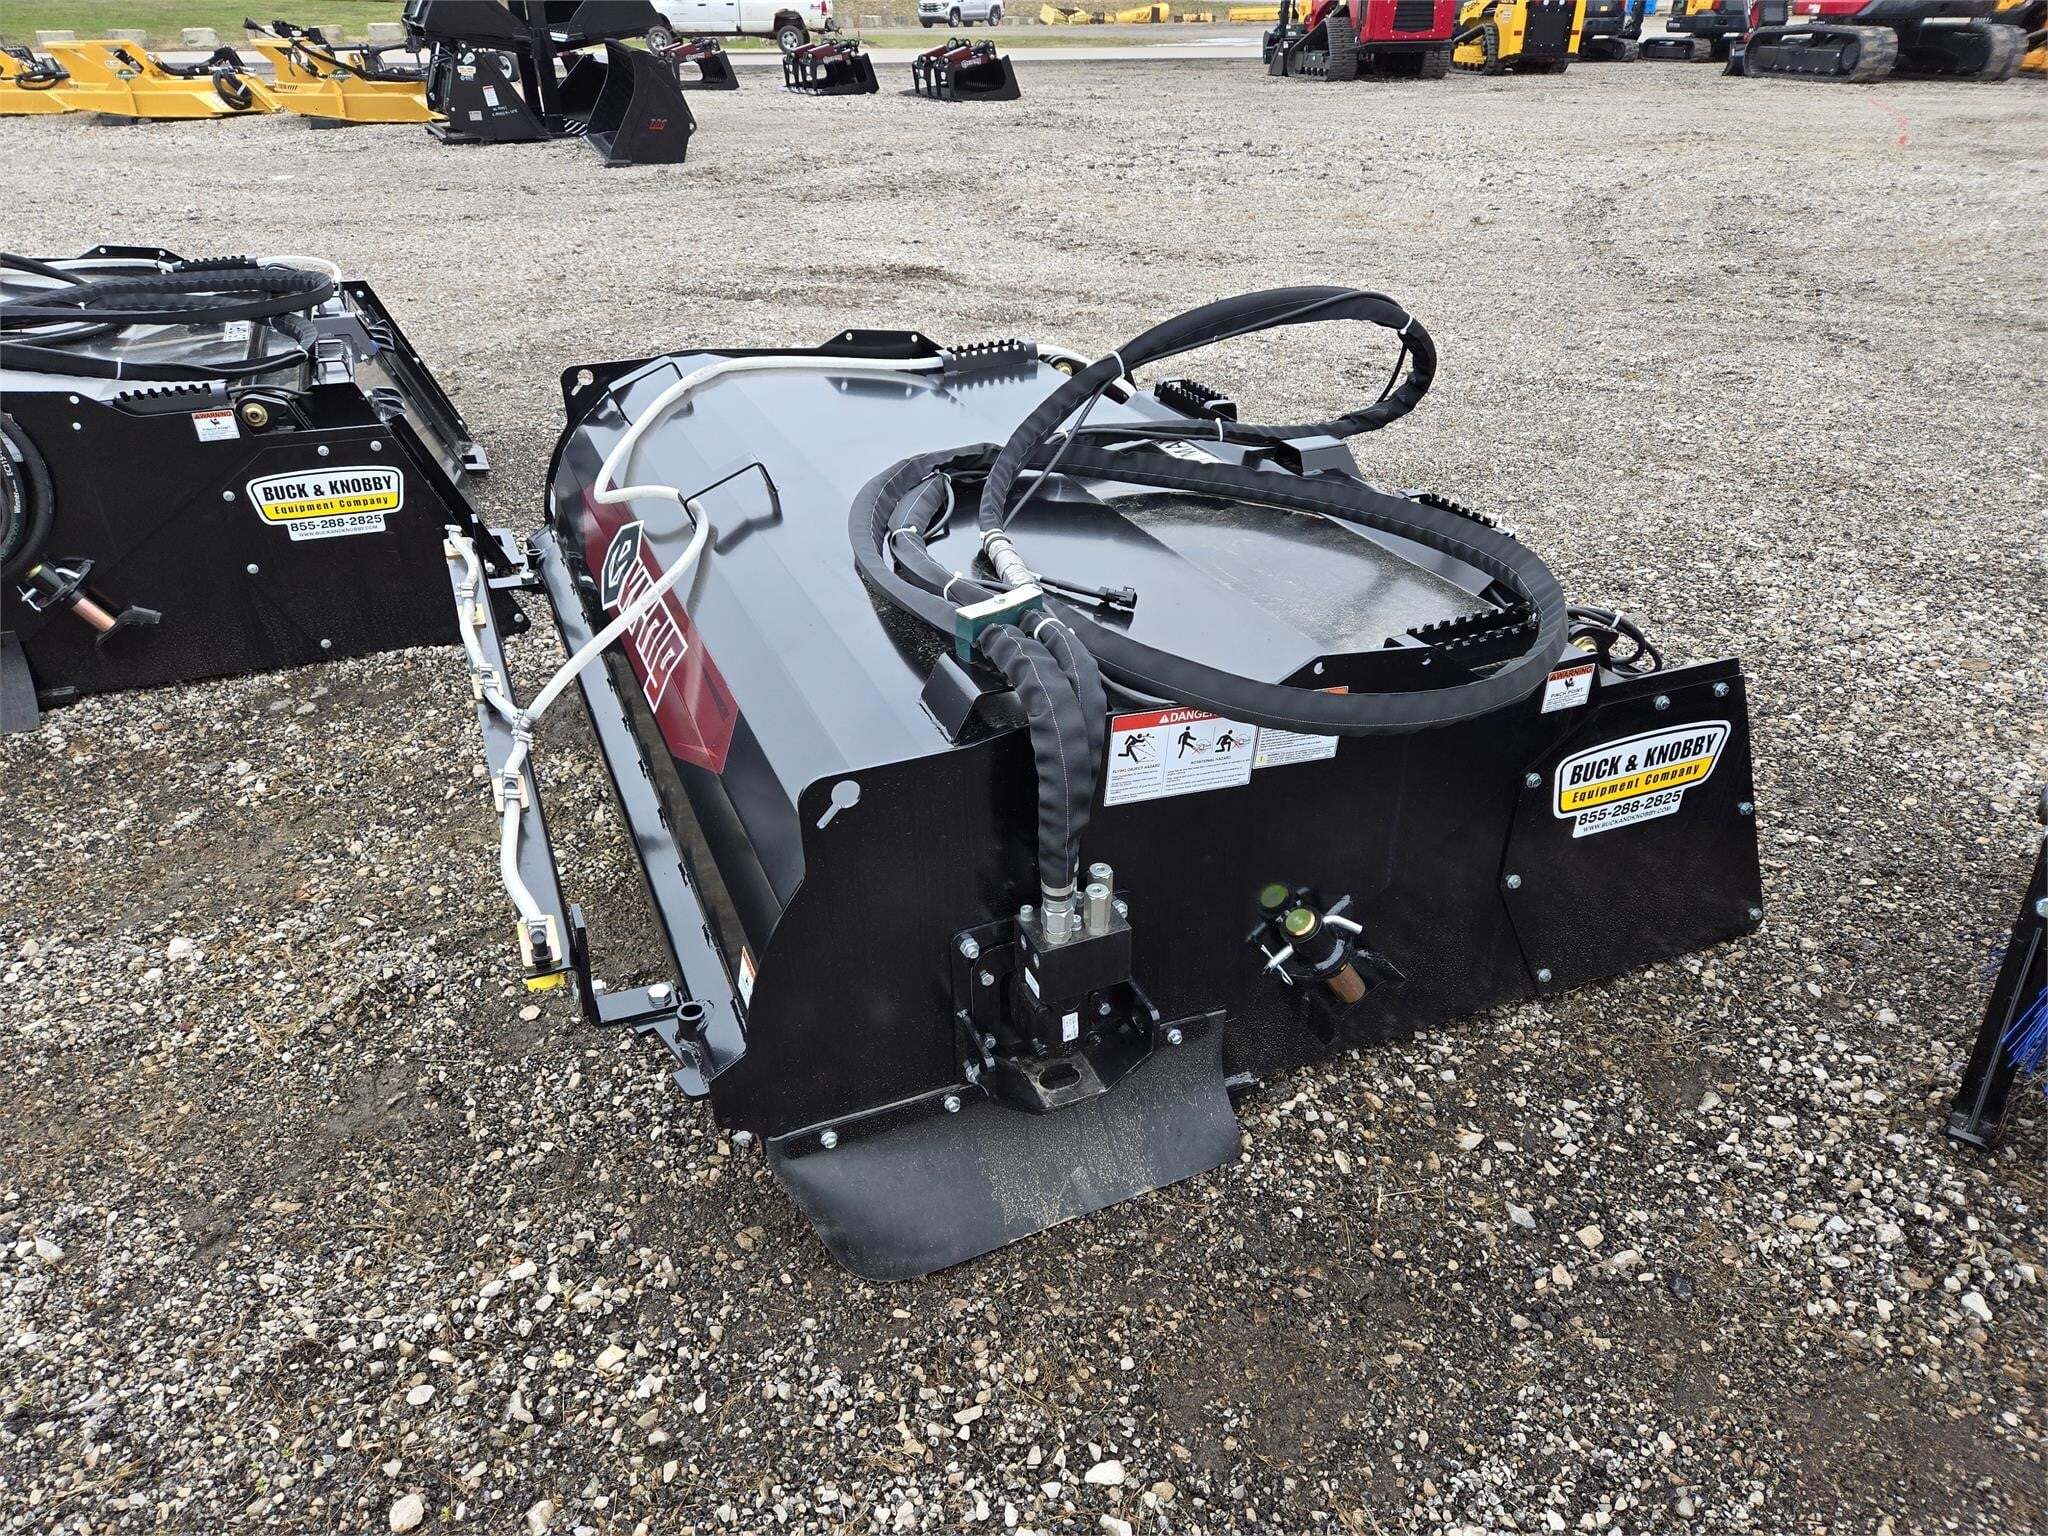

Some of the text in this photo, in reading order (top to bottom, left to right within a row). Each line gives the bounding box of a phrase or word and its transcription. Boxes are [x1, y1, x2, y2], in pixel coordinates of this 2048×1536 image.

[200, 411, 232, 419] WARNING
[262, 475, 392, 501] BUCK & KNOBBY
[274, 496, 388, 515] Equipment Company
[291, 514, 382, 532] 855-288-2825
[1556, 665, 1593, 679] WARNING
[1569, 732, 1718, 786] BUCK & KNOBBY
[1572, 764, 1700, 803] Equipment Company
[1578, 790, 1682, 826] 855-288-2825
